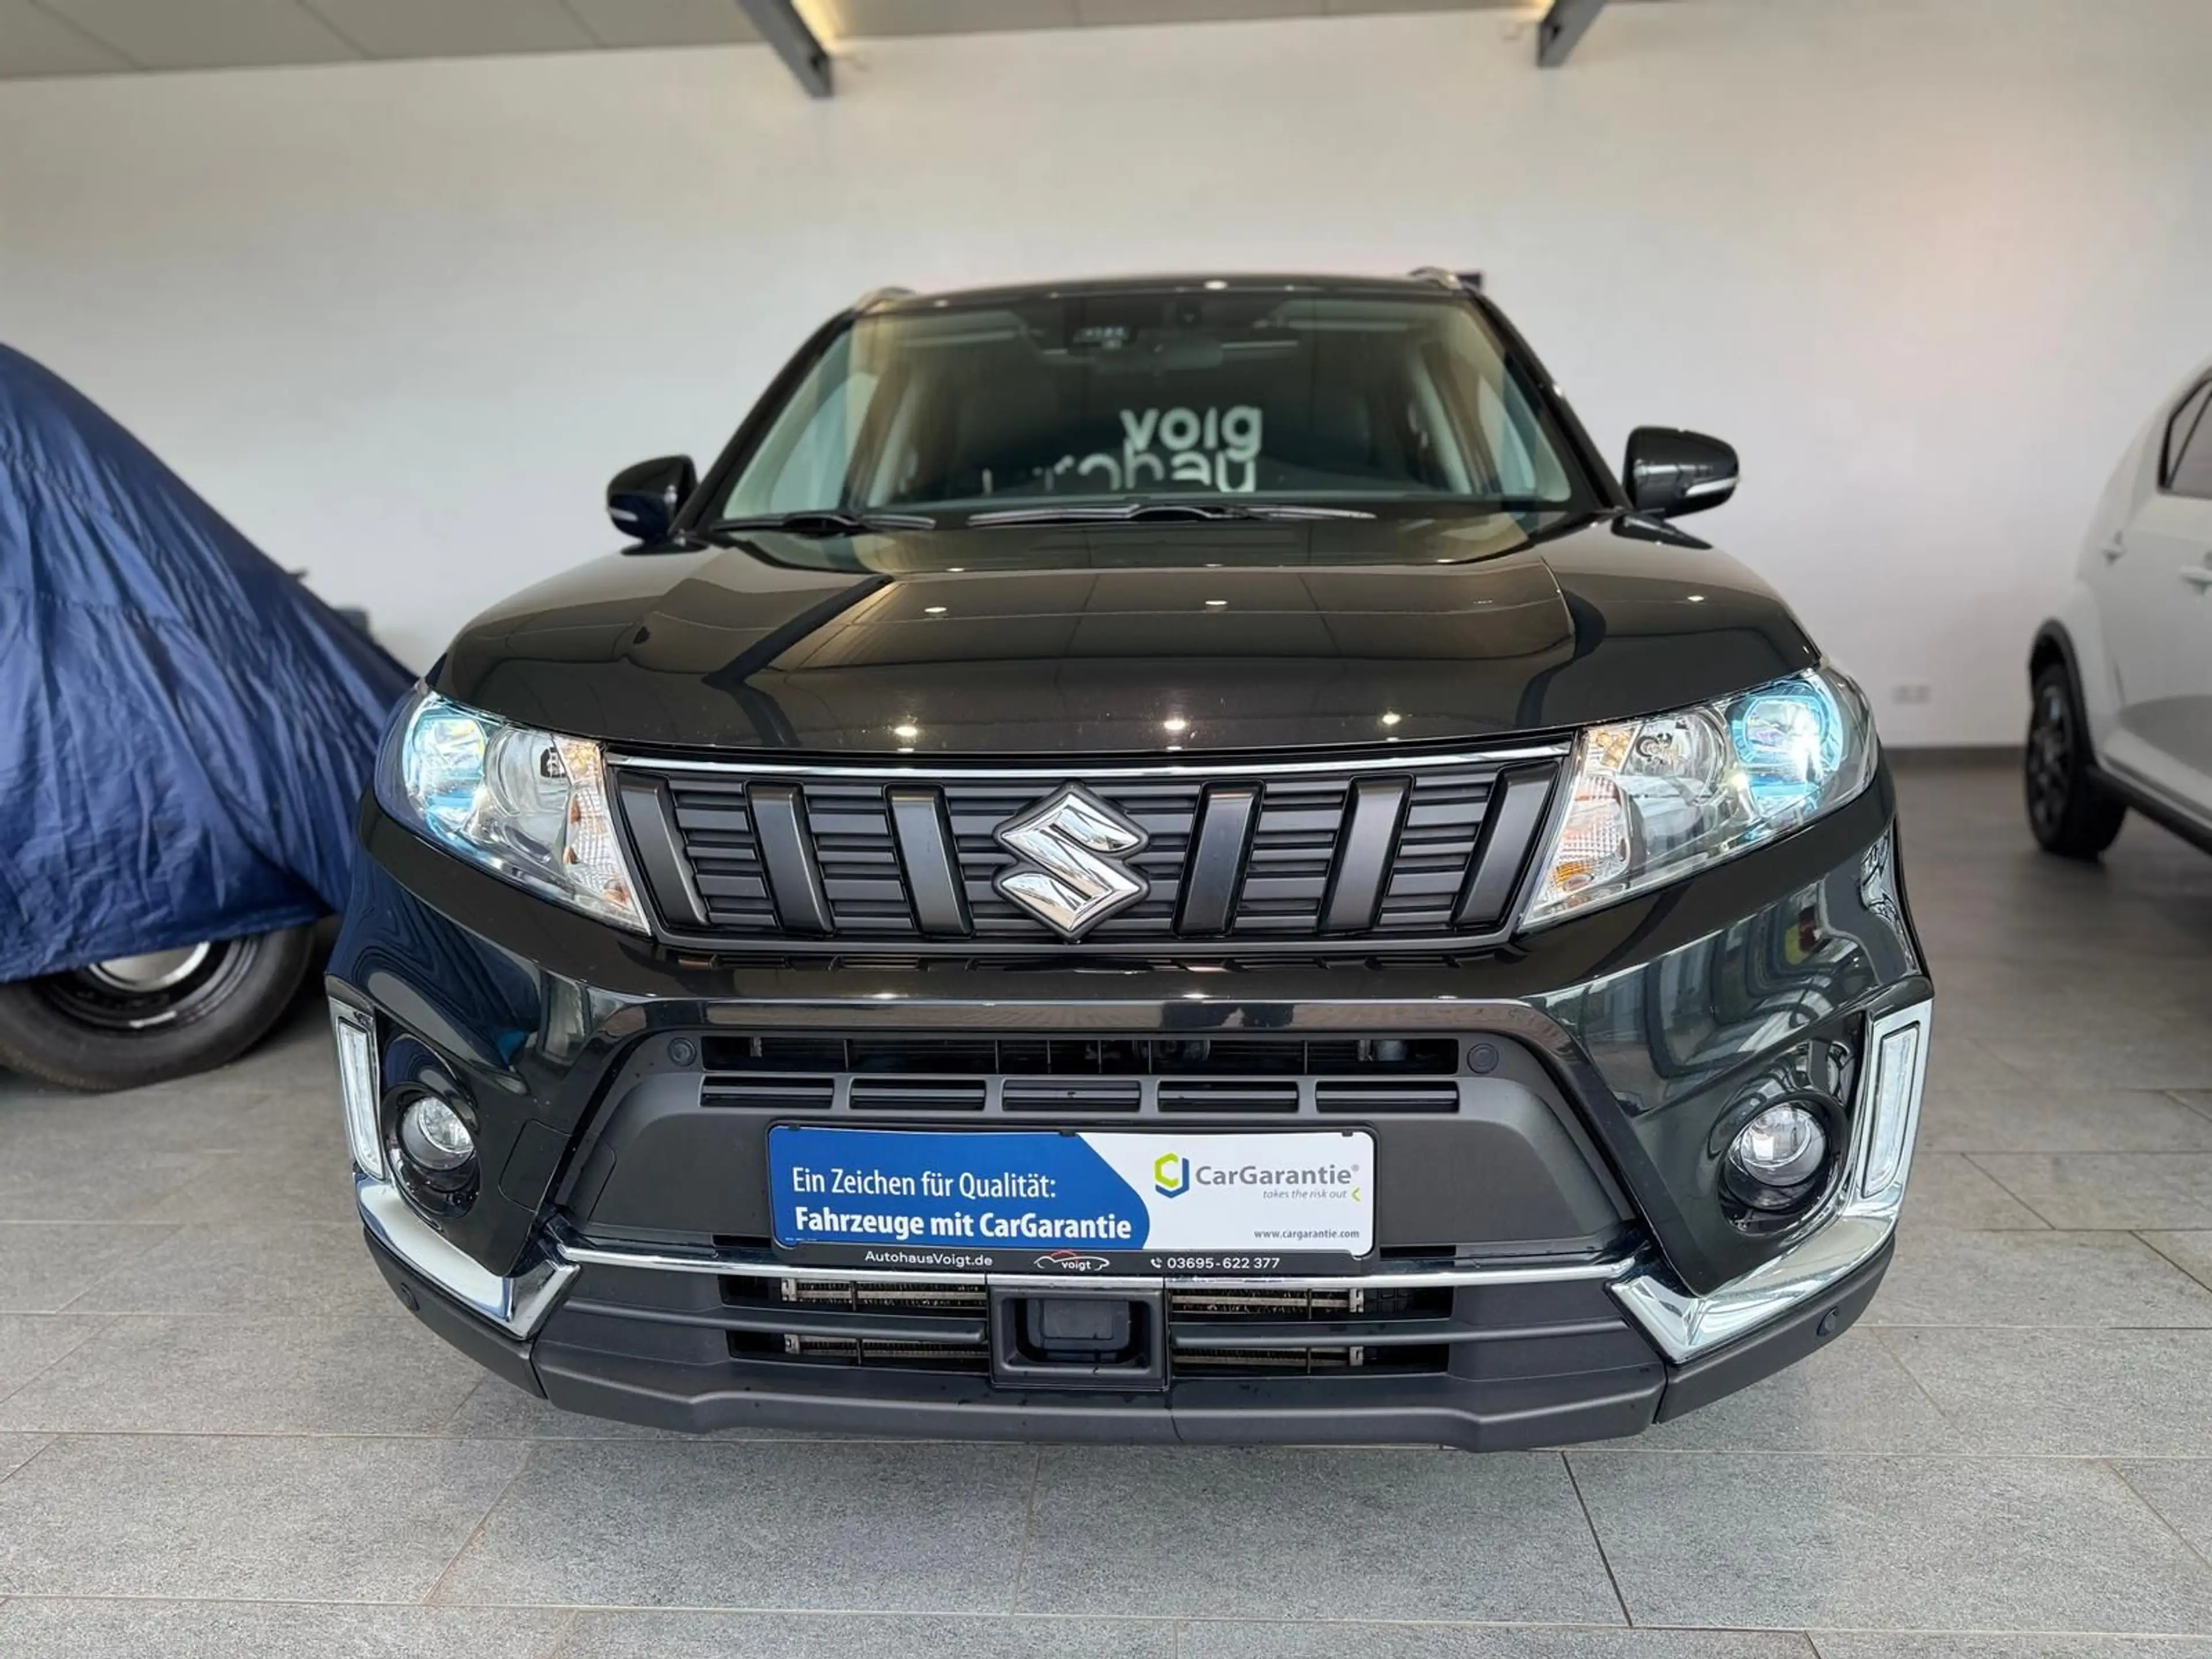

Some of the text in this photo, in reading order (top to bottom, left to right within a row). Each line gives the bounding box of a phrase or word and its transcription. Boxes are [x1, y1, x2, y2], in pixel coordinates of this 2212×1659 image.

[792, 1166, 1056, 1200] Ein Zeichen für Qualität:
[1263, 1189, 1347, 1199] takes the risk out
[795, 1206, 1132, 1240] Fahrzeuge mit CarGarantie
[1254, 1229, 1360, 1241] www.cargarantie.com
[865, 1251, 993, 1267] AutohausVoigt.de
[1062, 1258, 1092, 1271] voigt
[1167, 1257, 1280, 1269] 03695-622 377
